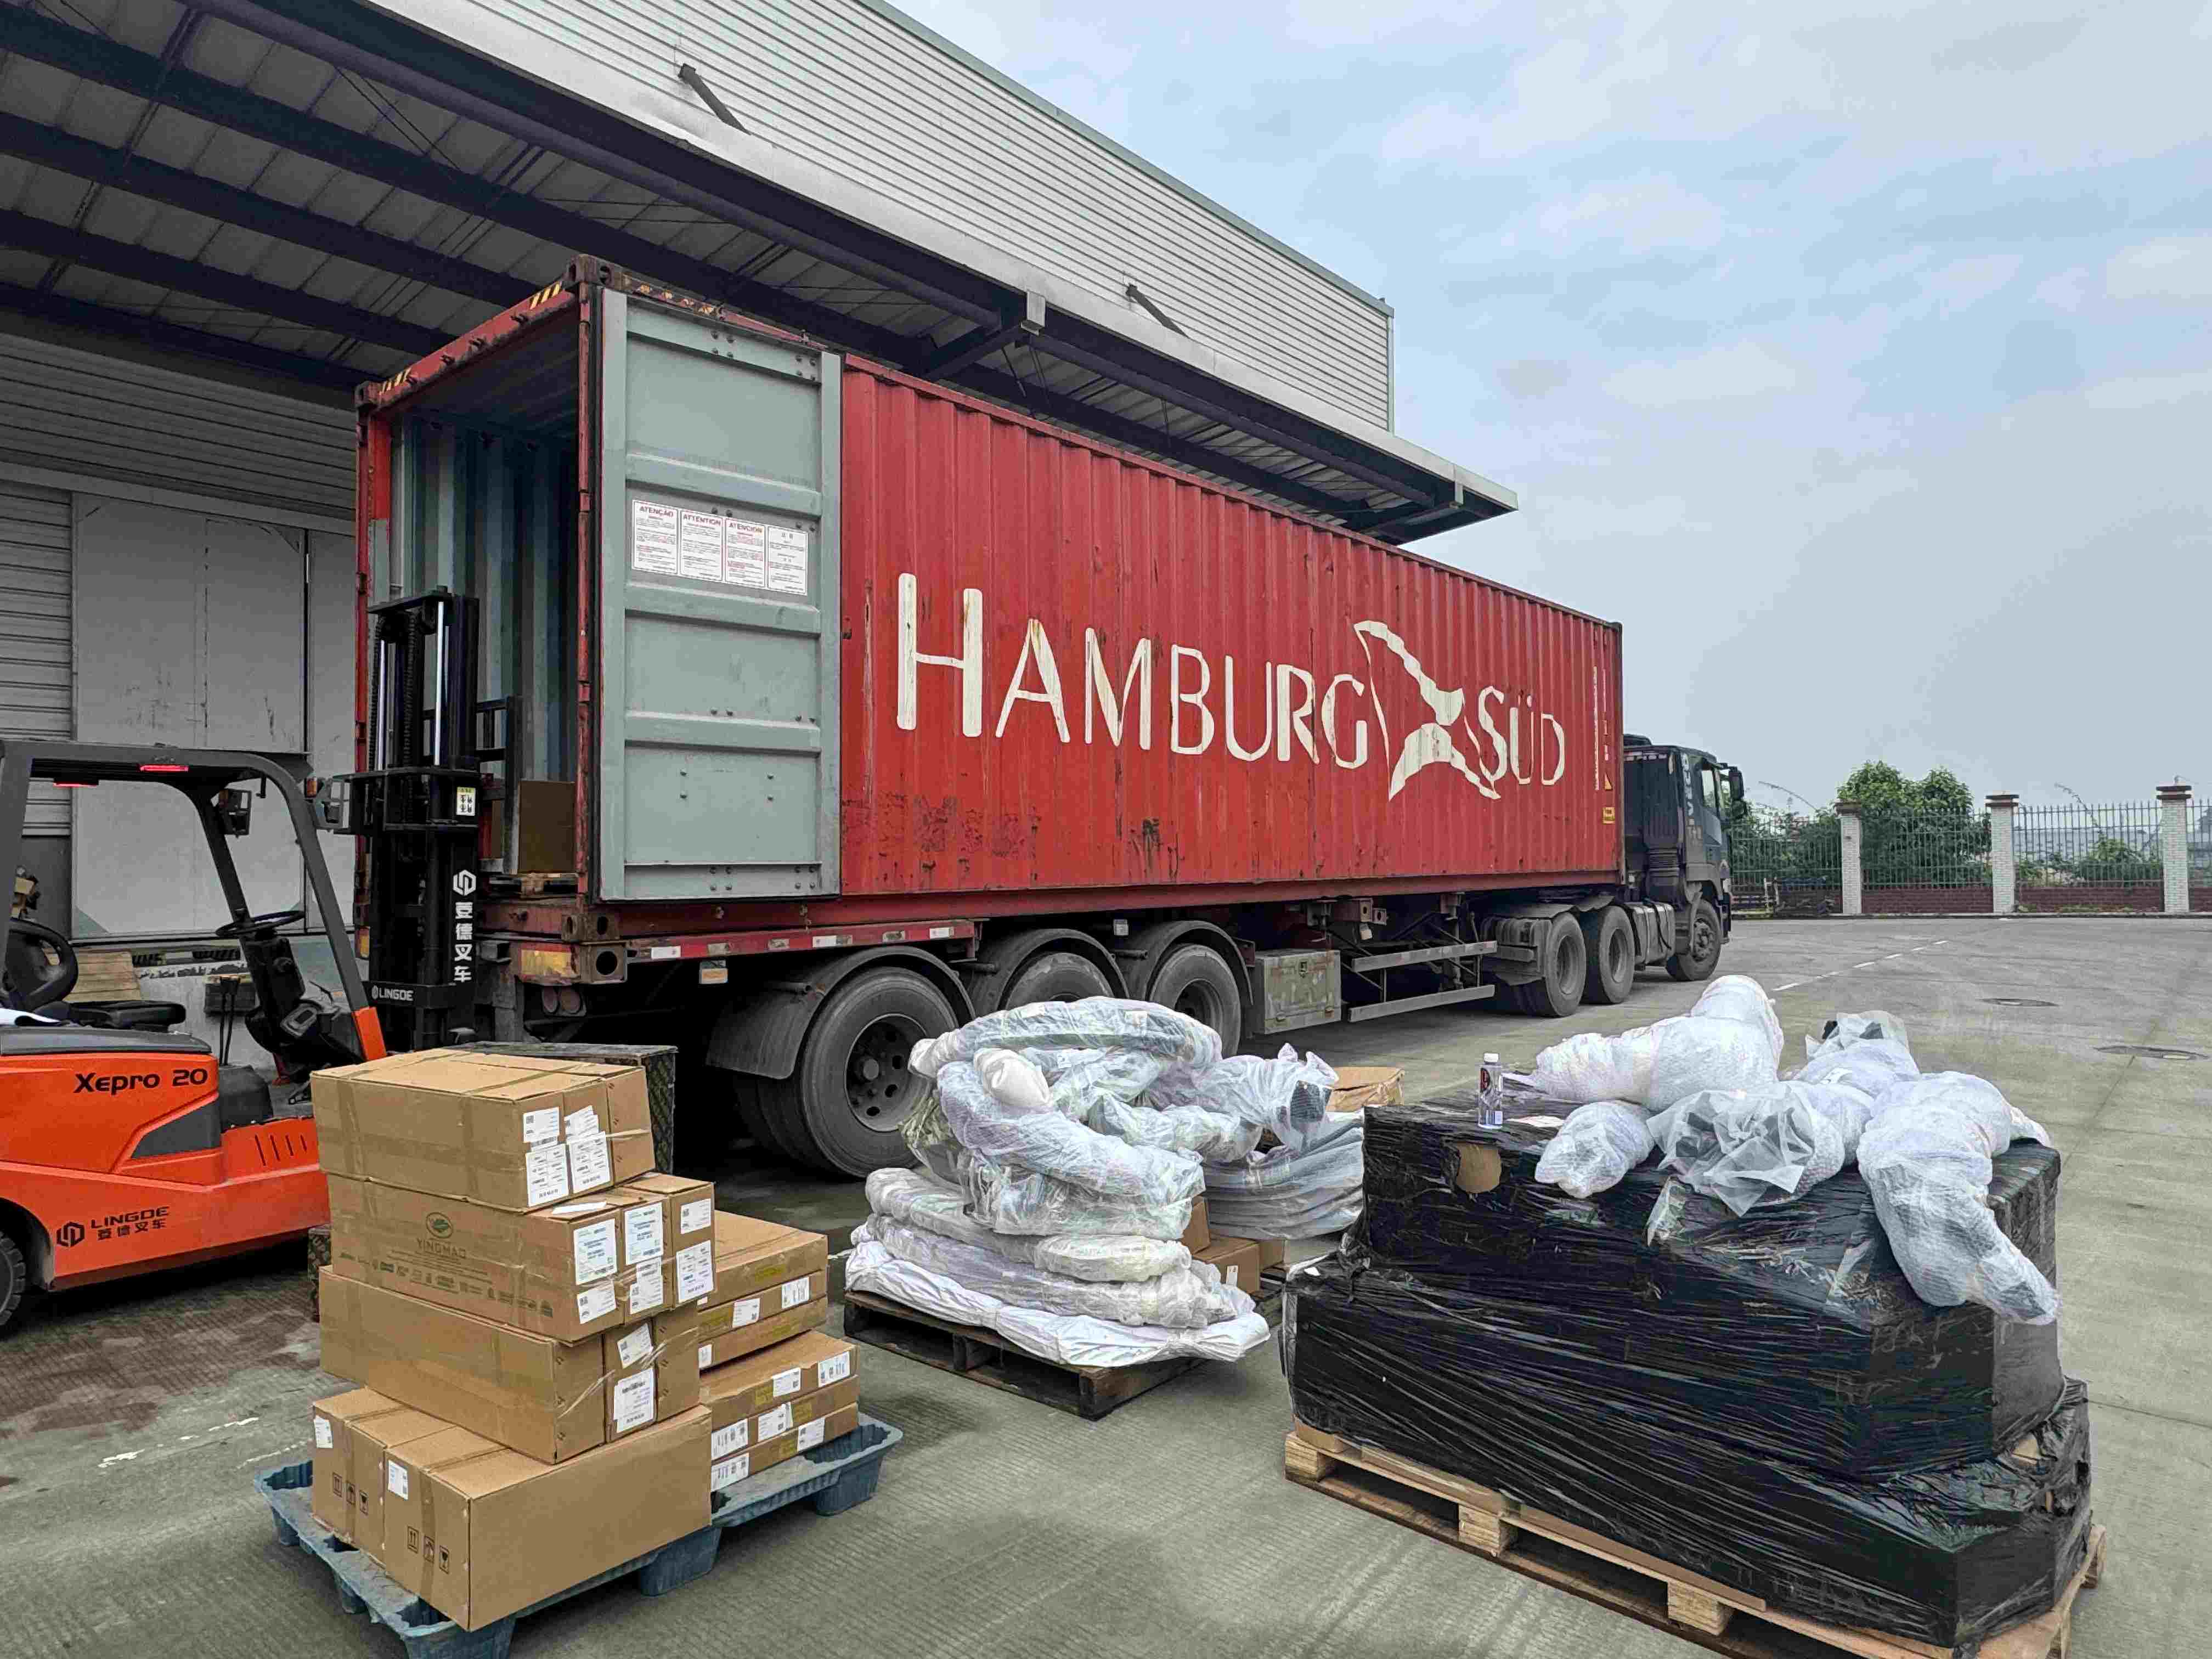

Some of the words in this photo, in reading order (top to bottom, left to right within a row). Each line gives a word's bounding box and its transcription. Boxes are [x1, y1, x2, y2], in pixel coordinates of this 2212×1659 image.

[684, 514, 721, 525] ATTENTION
[896, 573, 1368, 769] HAMBURG
[1479, 685, 1565, 785] SÜD
[379, 988, 414, 1001] LINGDE
[74, 1073, 160, 1096] Xepro
[172, 1068, 208, 1087] 20
[91, 1206, 170, 1229] LINGDE
